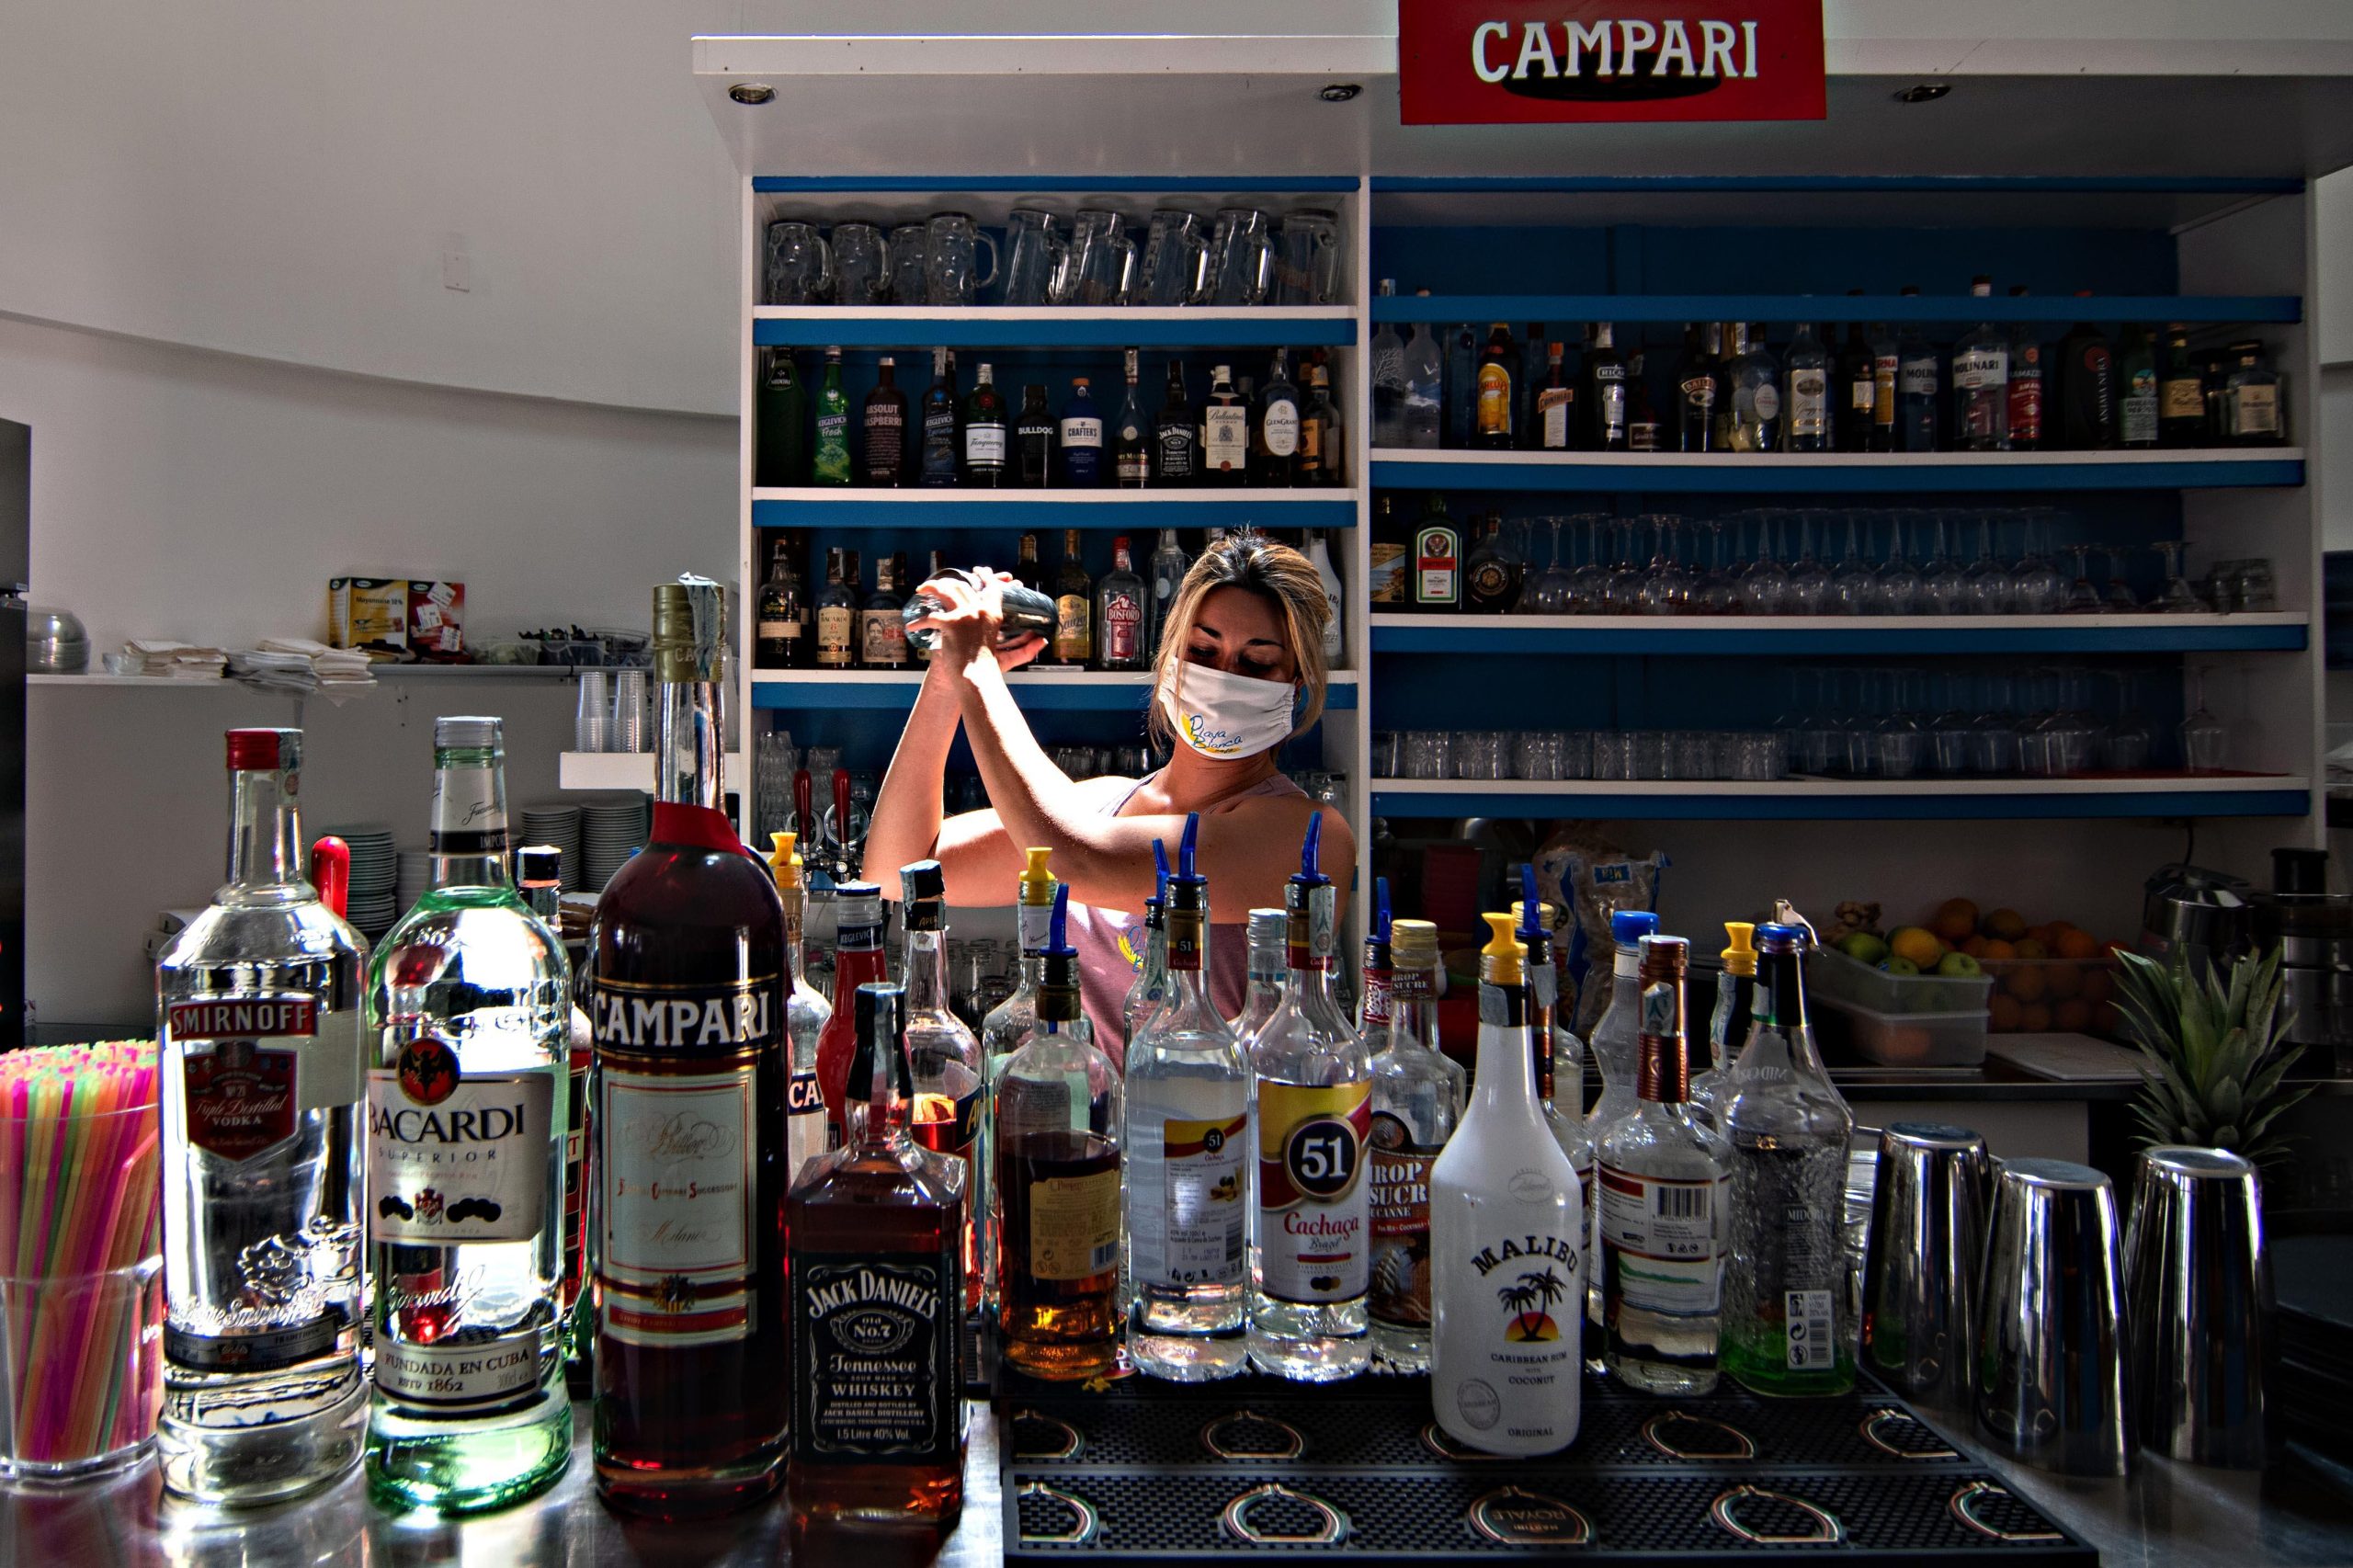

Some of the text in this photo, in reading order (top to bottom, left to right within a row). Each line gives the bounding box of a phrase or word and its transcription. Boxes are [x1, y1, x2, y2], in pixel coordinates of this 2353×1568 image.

[1472, 19, 1758, 83] CAMPARI
[1017, 426, 1053, 435] BULLDOG
[1108, 608, 1140, 621] BOSFORD
[1189, 715, 1226, 739] Playa
[1193, 734, 1244, 749] Blanca
[1179, 940, 1192, 952] 51
[171, 1005, 310, 1036] SMIRNOFF
[594, 990, 770, 1047] CAMPARI
[212, 1116, 262, 1127] VODKA
[369, 1104, 525, 1142] BACARDI
[1208, 1134, 1221, 1147] 51
[379, 1143, 497, 1165] SUPERIOR
[1301, 1136, 1347, 1178] 51
[1283, 1211, 1358, 1240] Cachaça
[806, 1268, 942, 1319] JACK DANIEL'S
[384, 1348, 529, 1376] FUNDADA EN CUBA
[829, 1354, 917, 1373] Tennessee
[1491, 1351, 1567, 1364] CARIBBEAN RUM
[426, 1379, 463, 1392] 1862
[1508, 1376, 1555, 1385] COCONUT
[831, 1383, 916, 1397] WHISKEY
[823, 1409, 845, 1418] JACK
[851, 1428, 871, 1439] Litre
[873, 1427, 893, 1439] 40%
[1508, 1426, 1554, 1437] ORIGINAL
